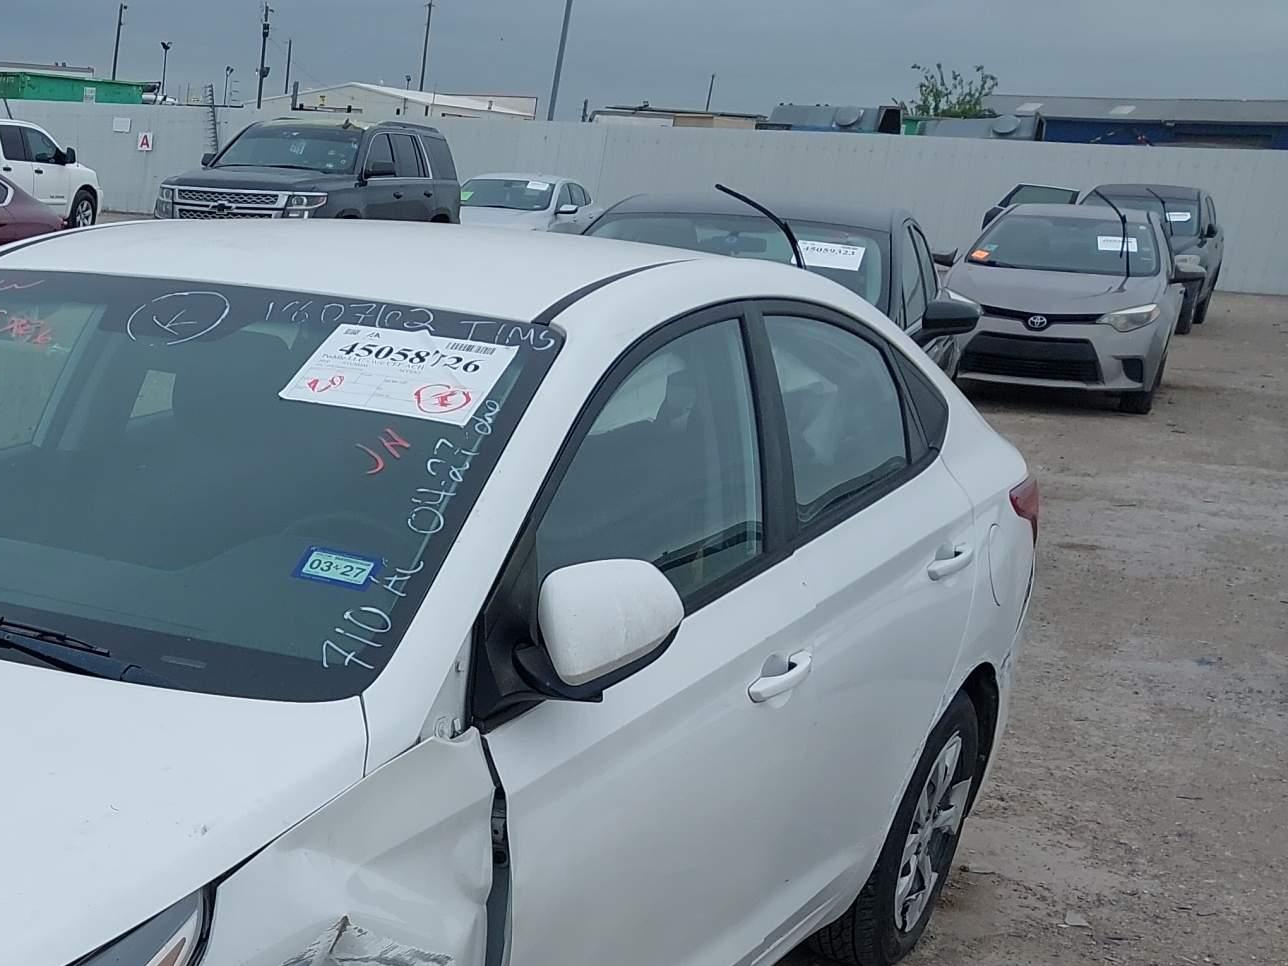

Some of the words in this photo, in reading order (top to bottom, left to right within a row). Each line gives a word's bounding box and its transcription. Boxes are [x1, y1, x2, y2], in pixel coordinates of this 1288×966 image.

[140, 134, 150, 148] A
[339, 341, 484, 374] 45058726
[309, 558, 333, 572] 03
[340, 564, 366, 578] 27
